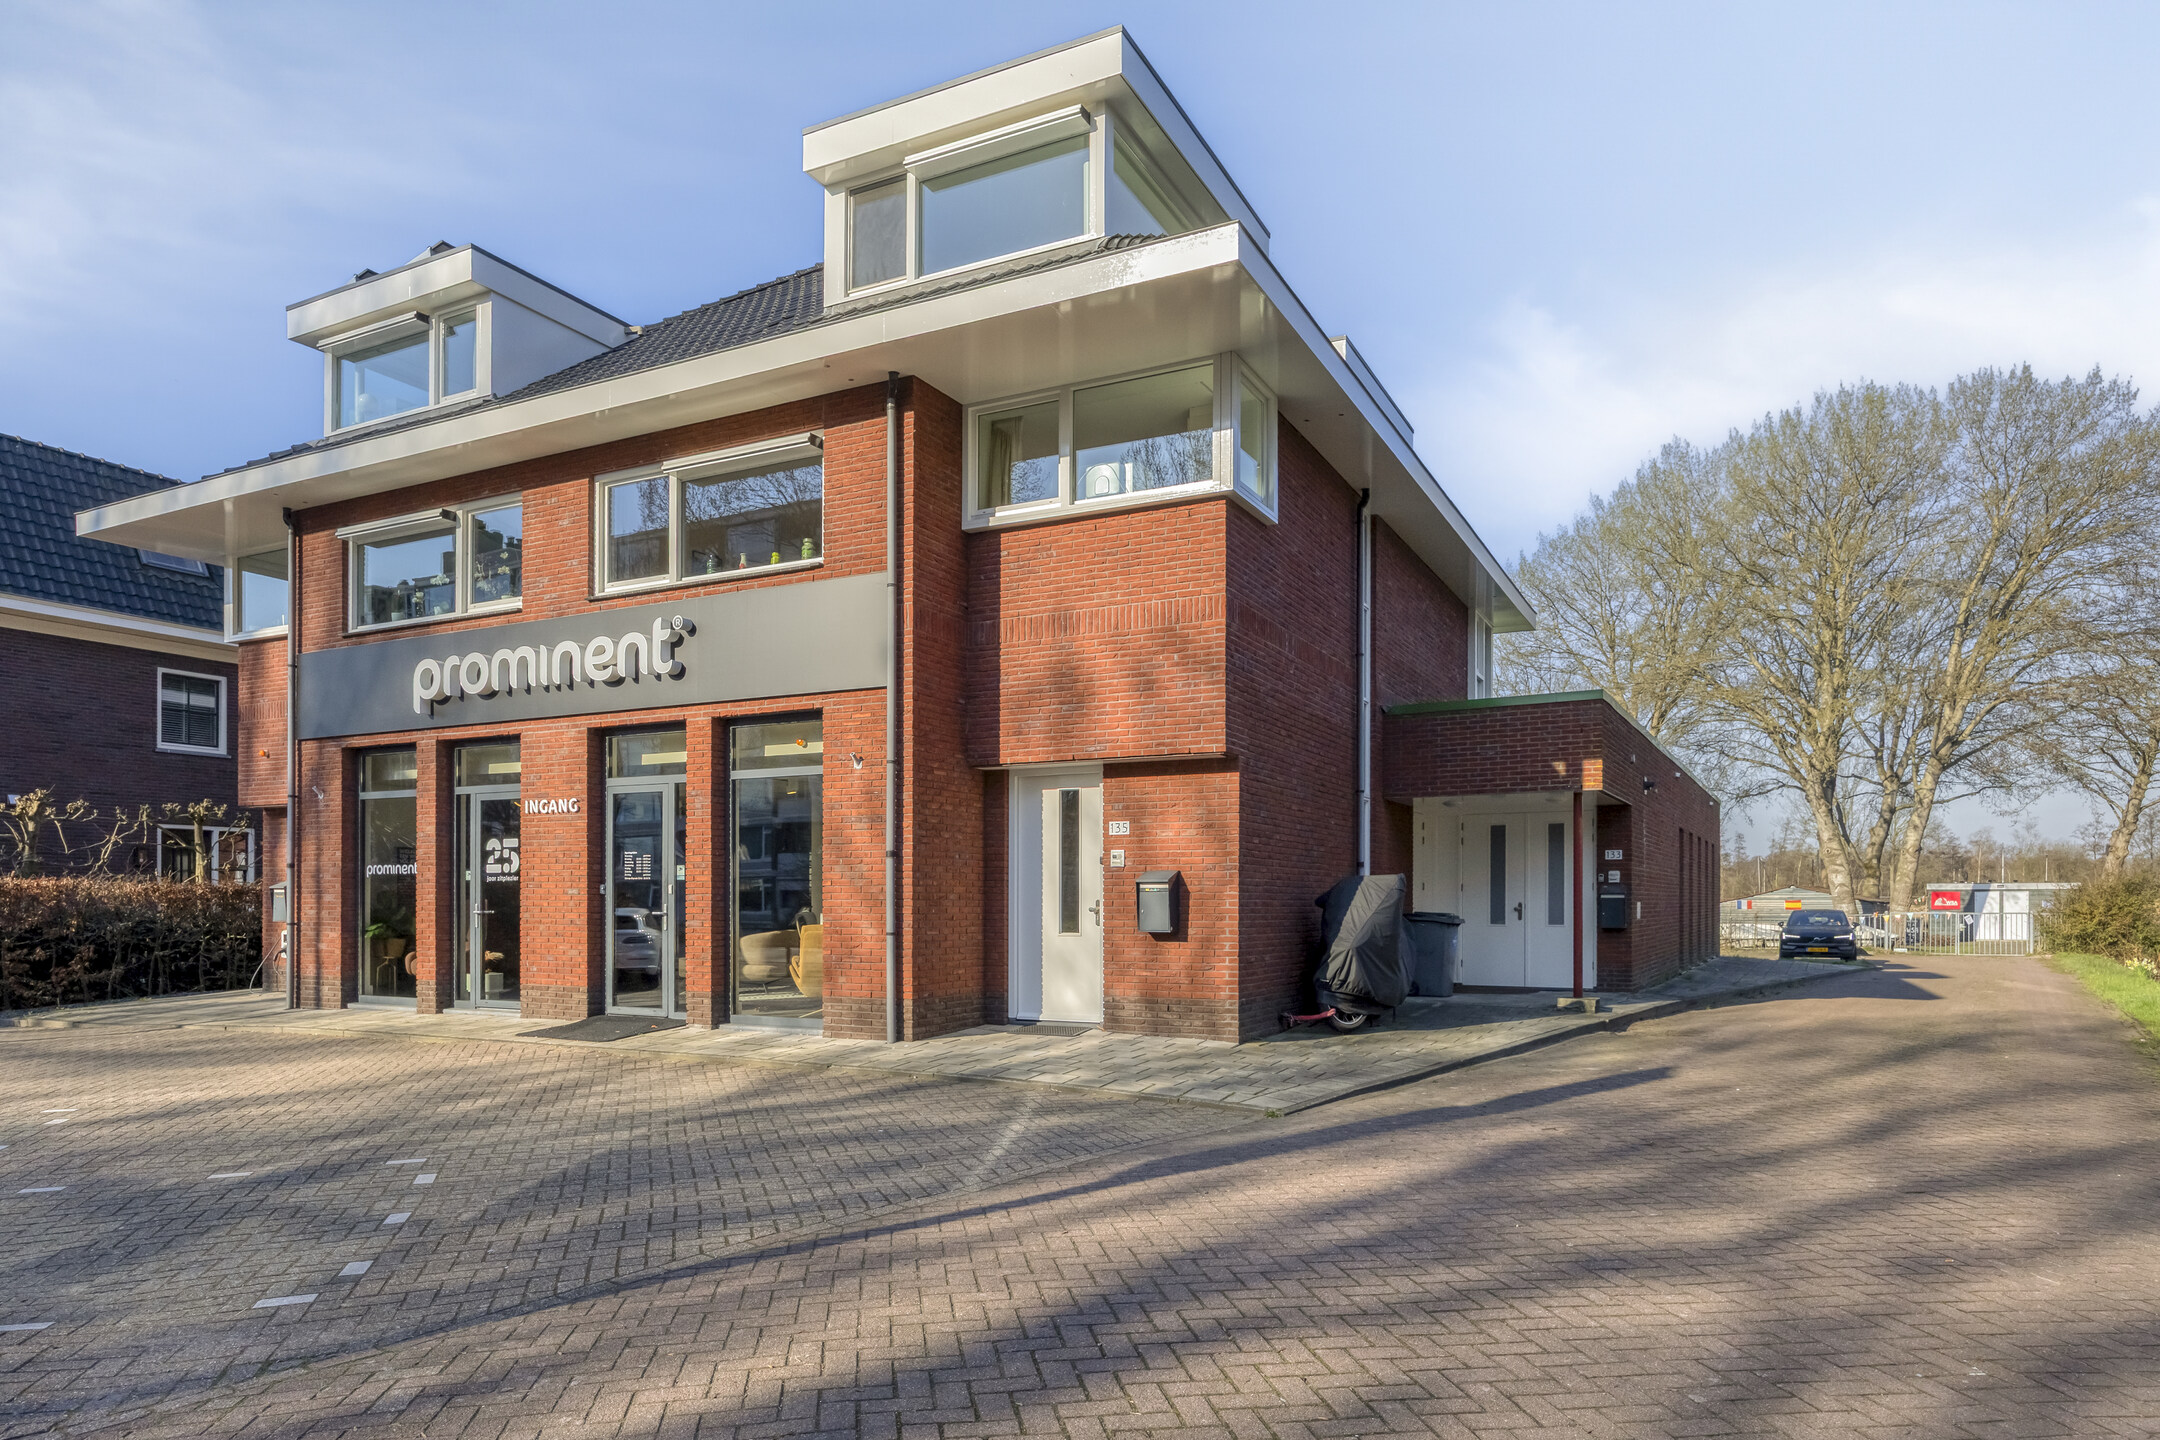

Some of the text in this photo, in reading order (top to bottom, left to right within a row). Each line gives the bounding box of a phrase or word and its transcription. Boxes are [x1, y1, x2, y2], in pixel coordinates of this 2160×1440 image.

[525, 798, 579, 814] INGANG
[1110, 822, 1128, 833] 135
[486, 838, 520, 873] 25
[1606, 851, 1621, 859] 133
[366, 861, 417, 878] prominent
